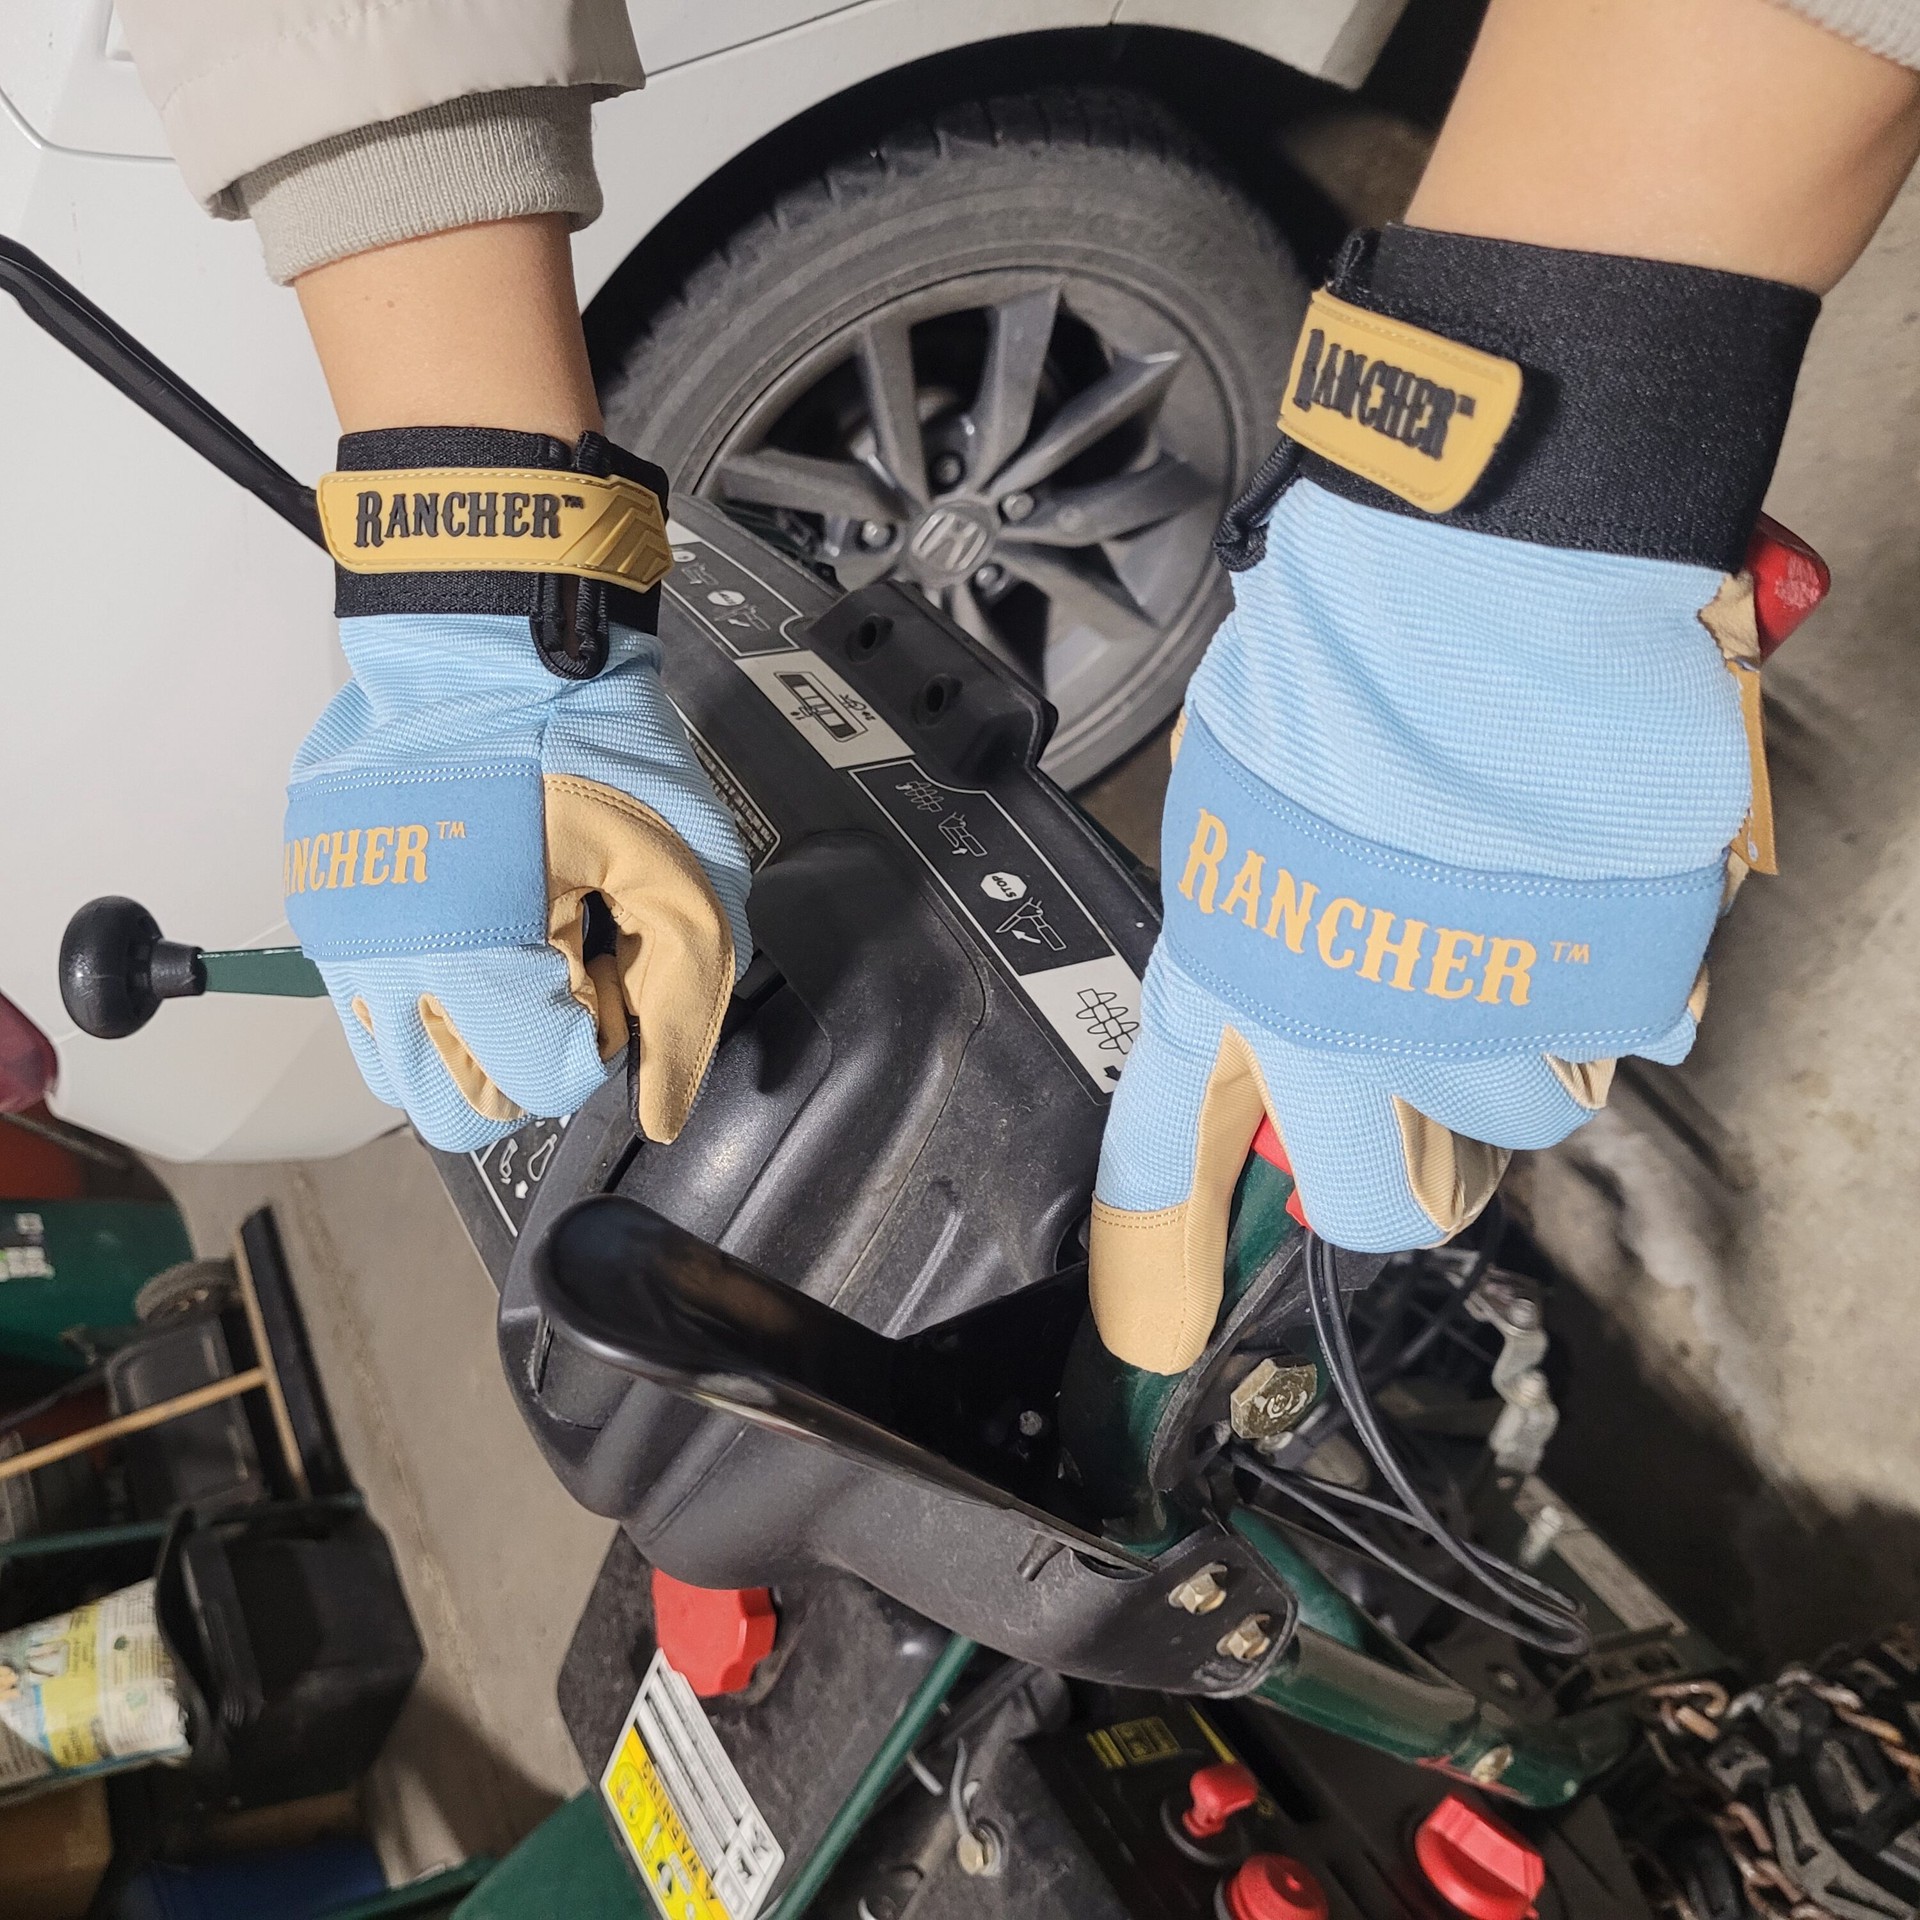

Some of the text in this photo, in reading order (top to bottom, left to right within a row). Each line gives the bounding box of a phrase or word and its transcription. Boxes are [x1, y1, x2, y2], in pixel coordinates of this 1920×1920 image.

[992, 875, 1017, 898] STOP
[1178, 808, 1590, 1006] RANCHER™
[641, 1759, 702, 1877] WARNING
